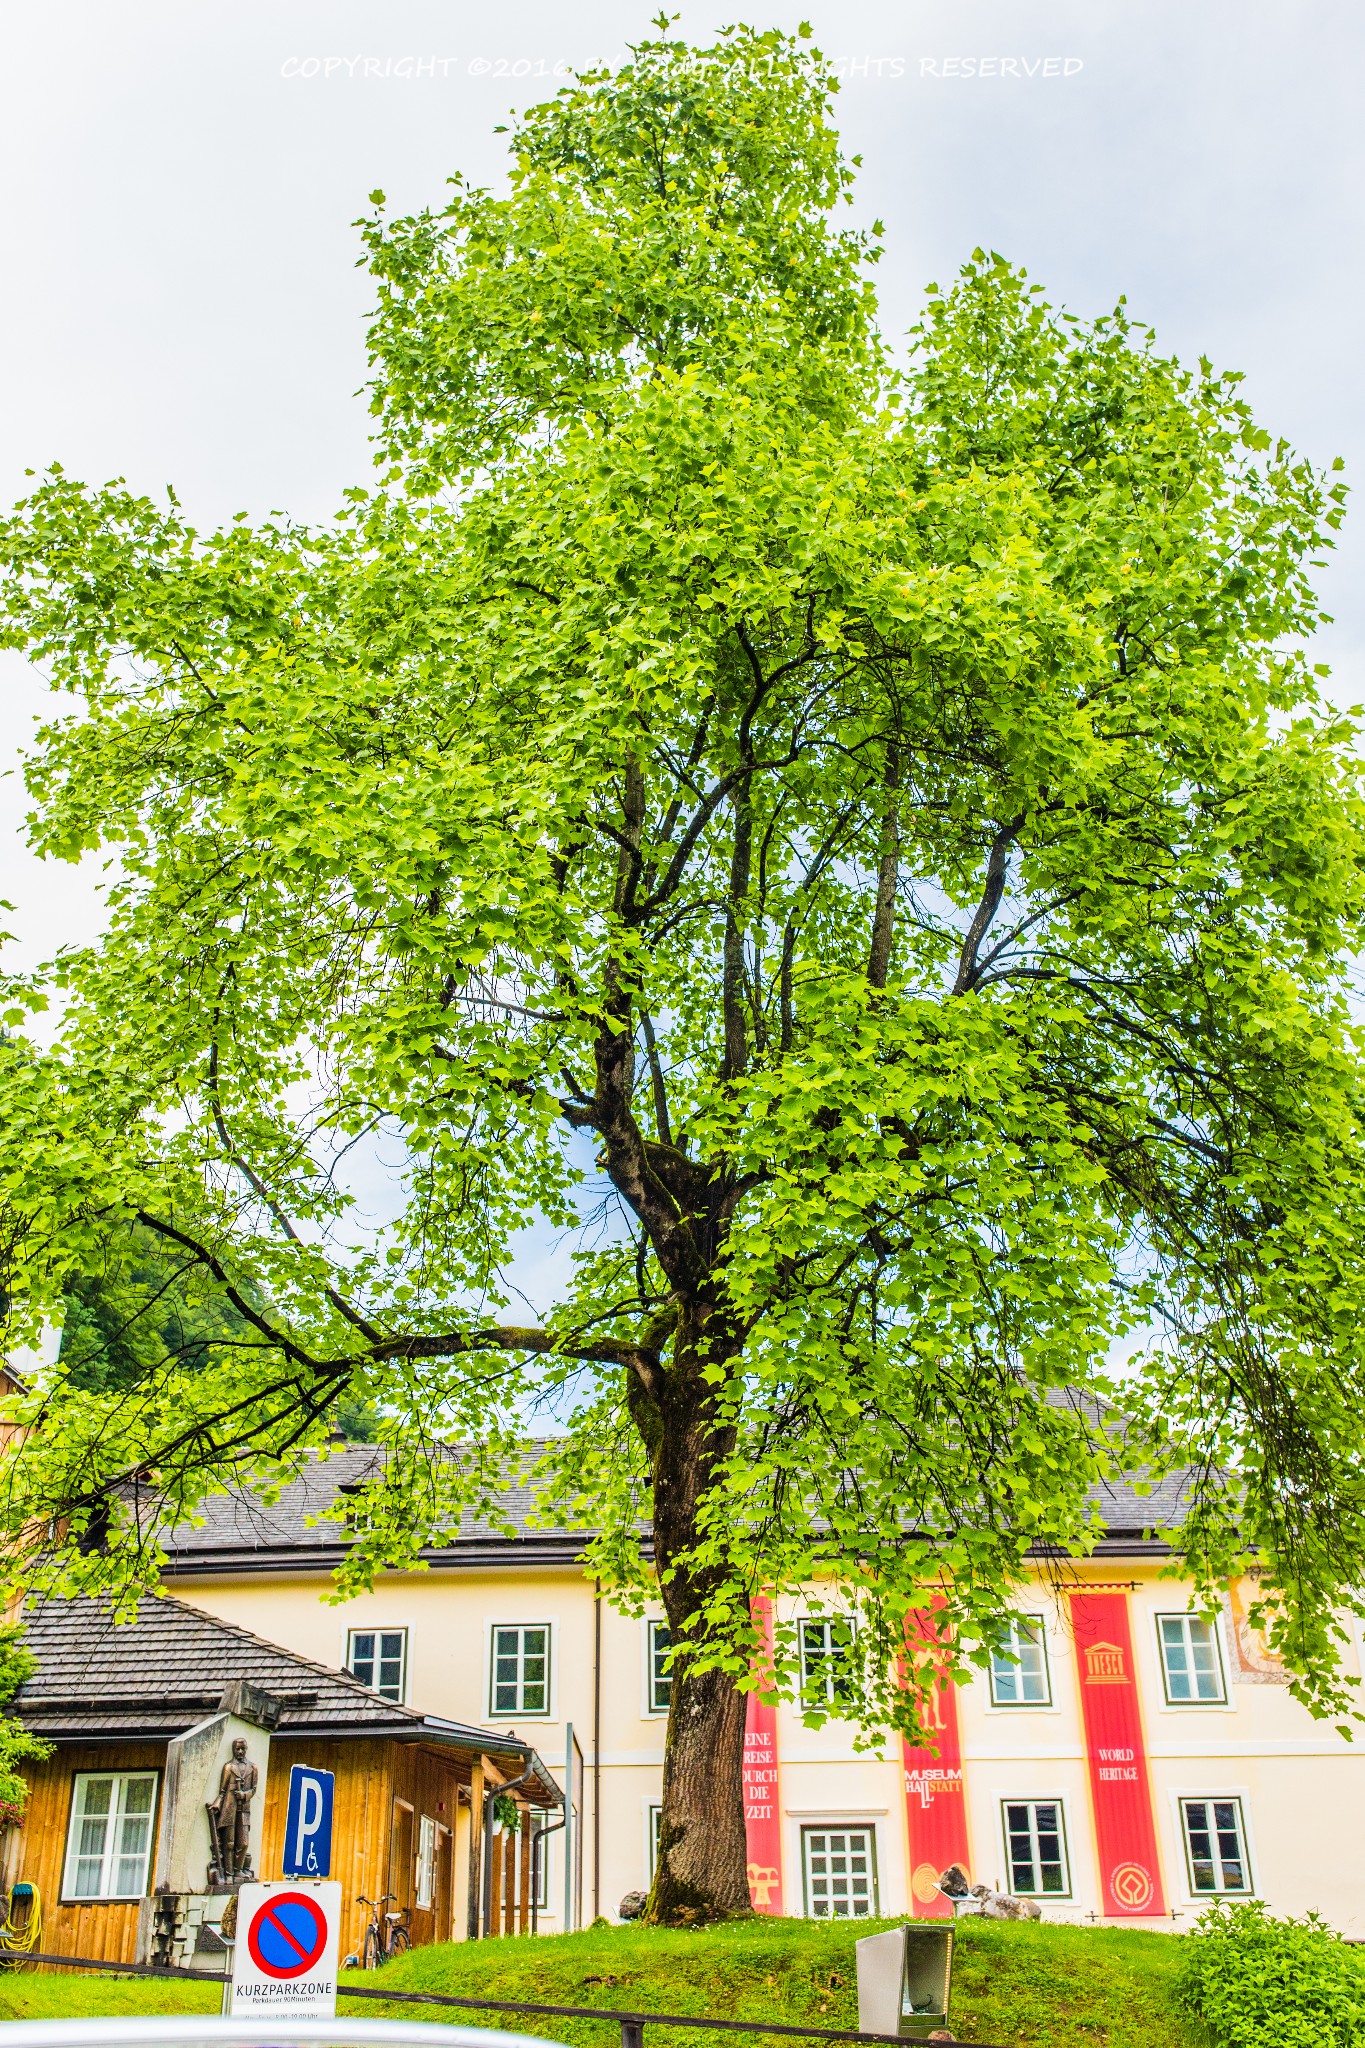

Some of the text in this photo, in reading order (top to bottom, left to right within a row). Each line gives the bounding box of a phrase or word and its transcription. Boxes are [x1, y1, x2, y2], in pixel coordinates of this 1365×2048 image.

[1087, 1654, 1124, 1675] UNESCO
[745, 1732, 771, 1746] EINE
[744, 1750, 773, 1764] REISE
[1098, 1748, 1134, 1761] WORLD
[904, 1769, 962, 1780] MUSEUM
[1099, 1767, 1138, 1781] HERITAGE
[749, 1786, 770, 1800] DIE
[905, 1780, 961, 1809] HALLSTATT
[746, 1805, 773, 1819] ZEIT
[294, 1776, 323, 1867] P
[236, 1982, 332, 1997] KURZPARKZONE
